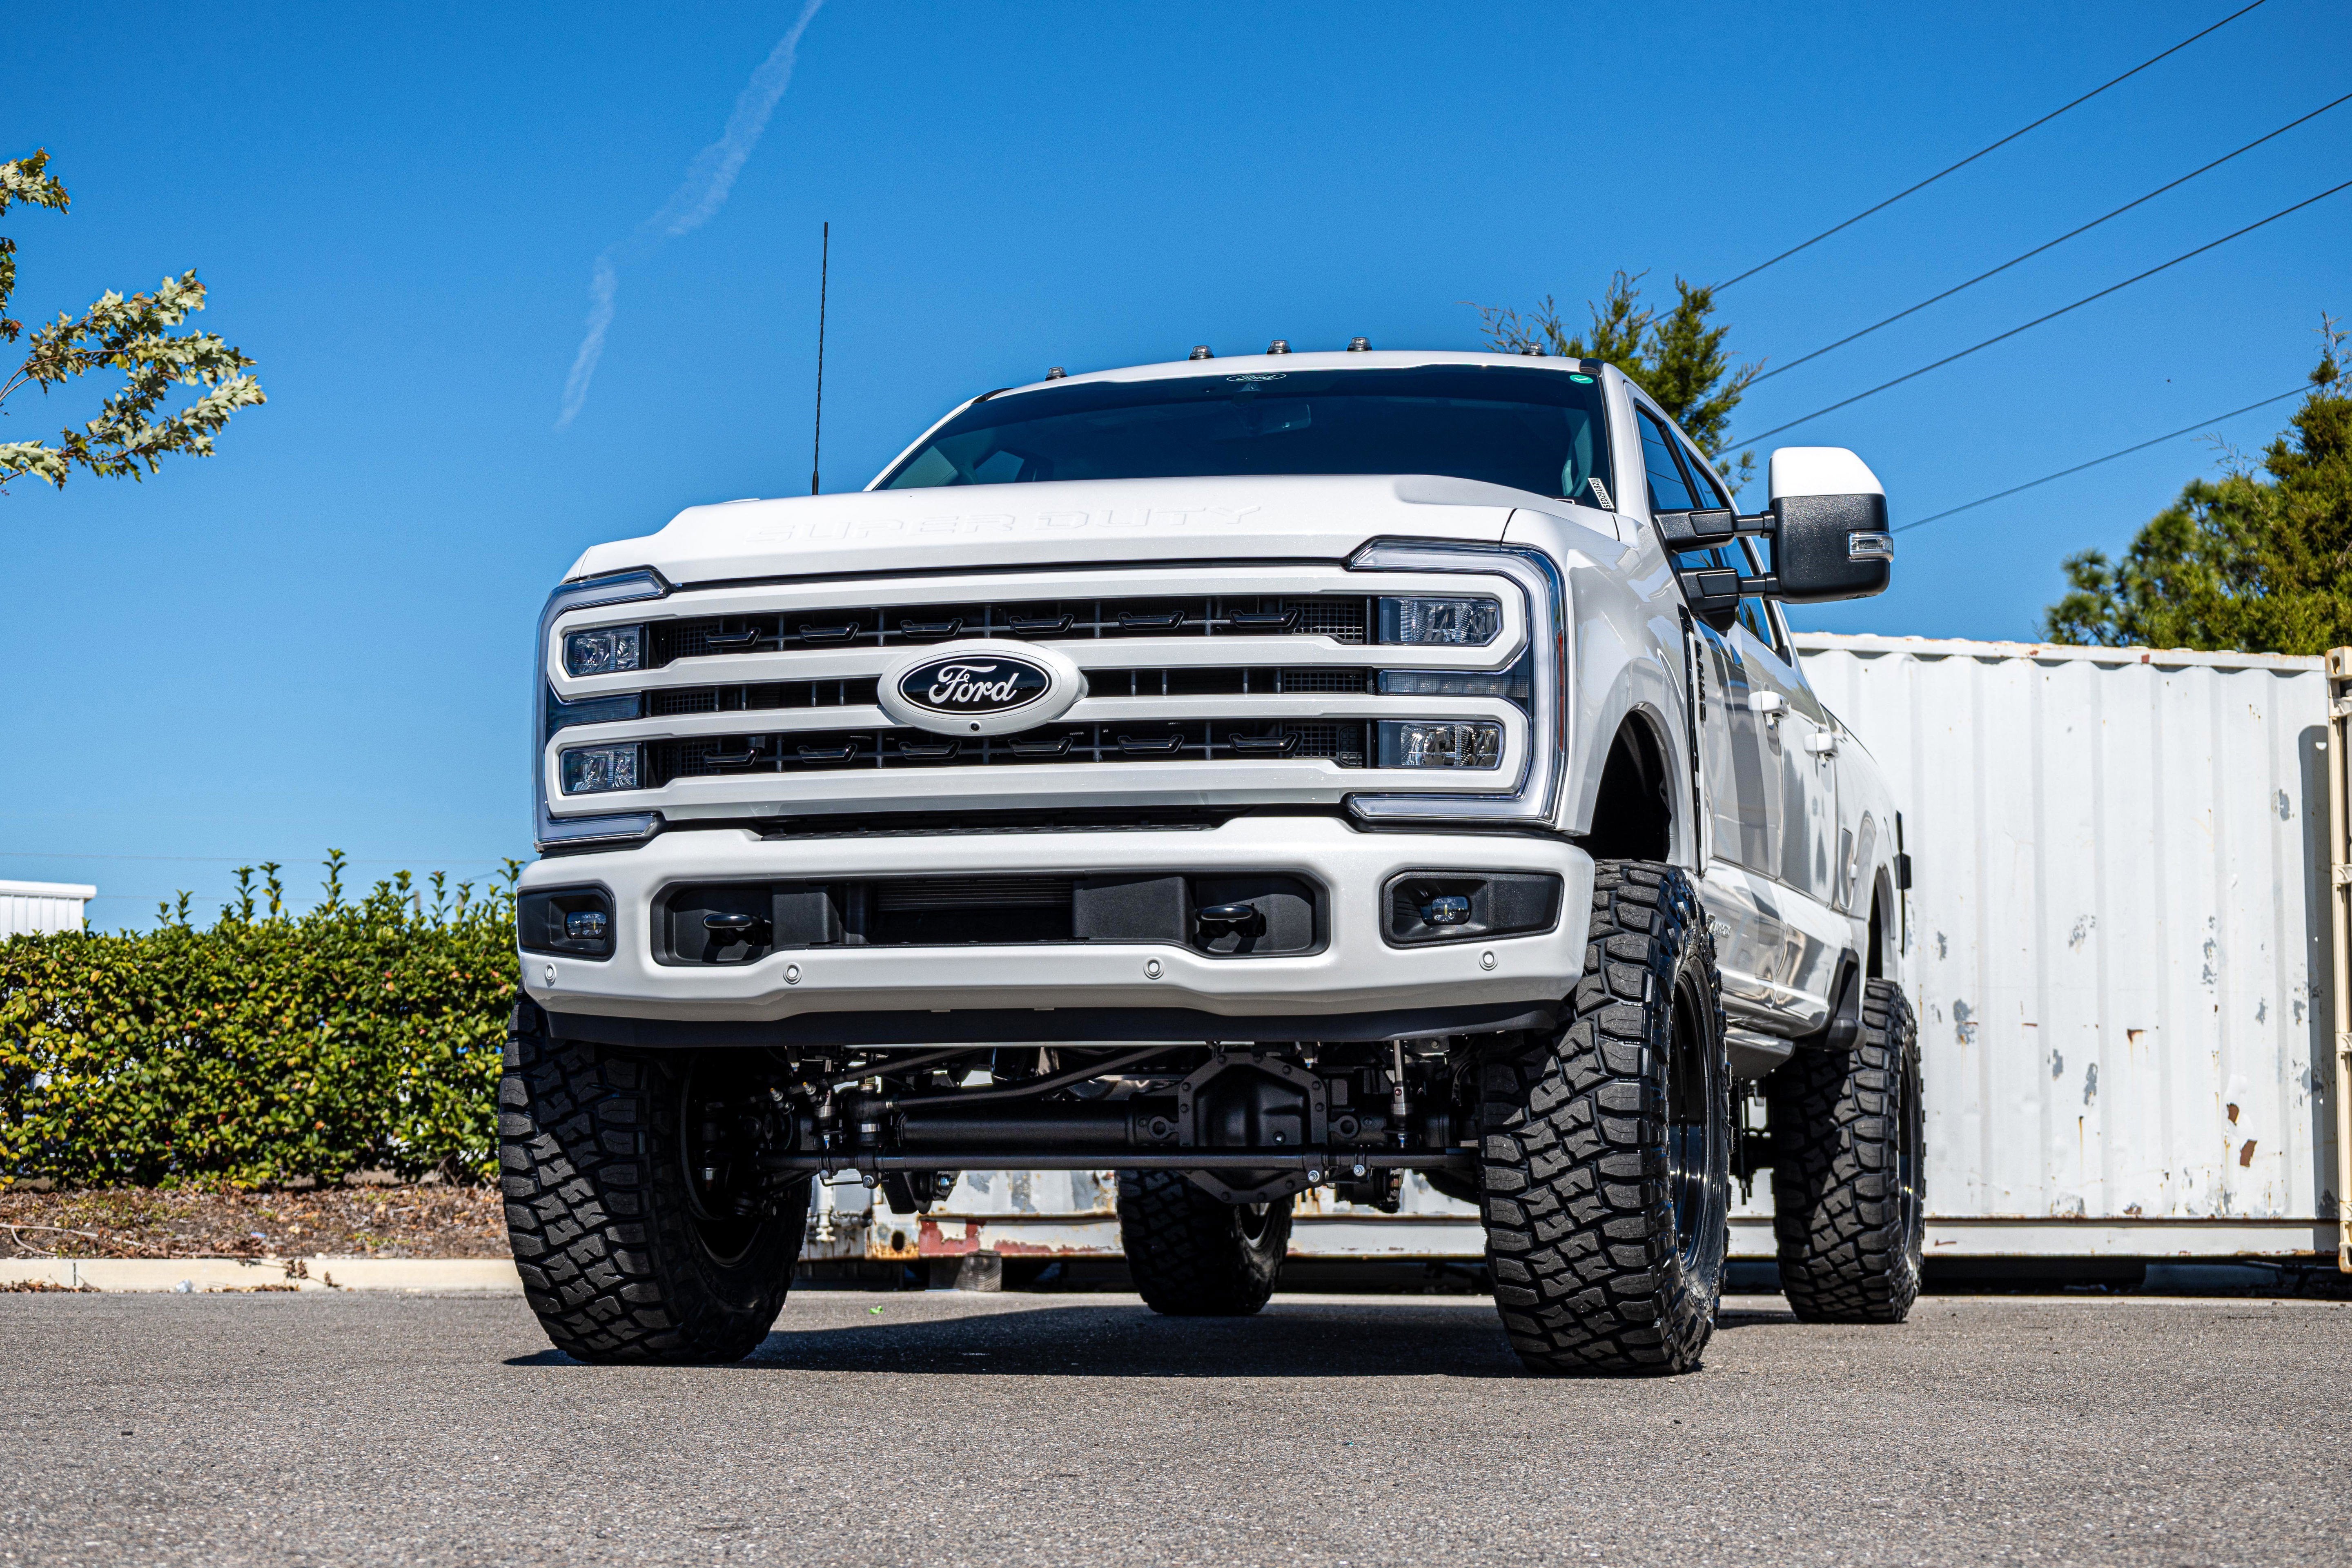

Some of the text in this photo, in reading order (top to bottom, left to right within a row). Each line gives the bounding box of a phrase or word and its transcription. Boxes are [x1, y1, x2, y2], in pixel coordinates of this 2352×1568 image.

[1592, 483, 1610, 508] SED29182
[744, 506, 1261, 545] SUPER DUTY
[929, 665, 1020, 704] Ford
